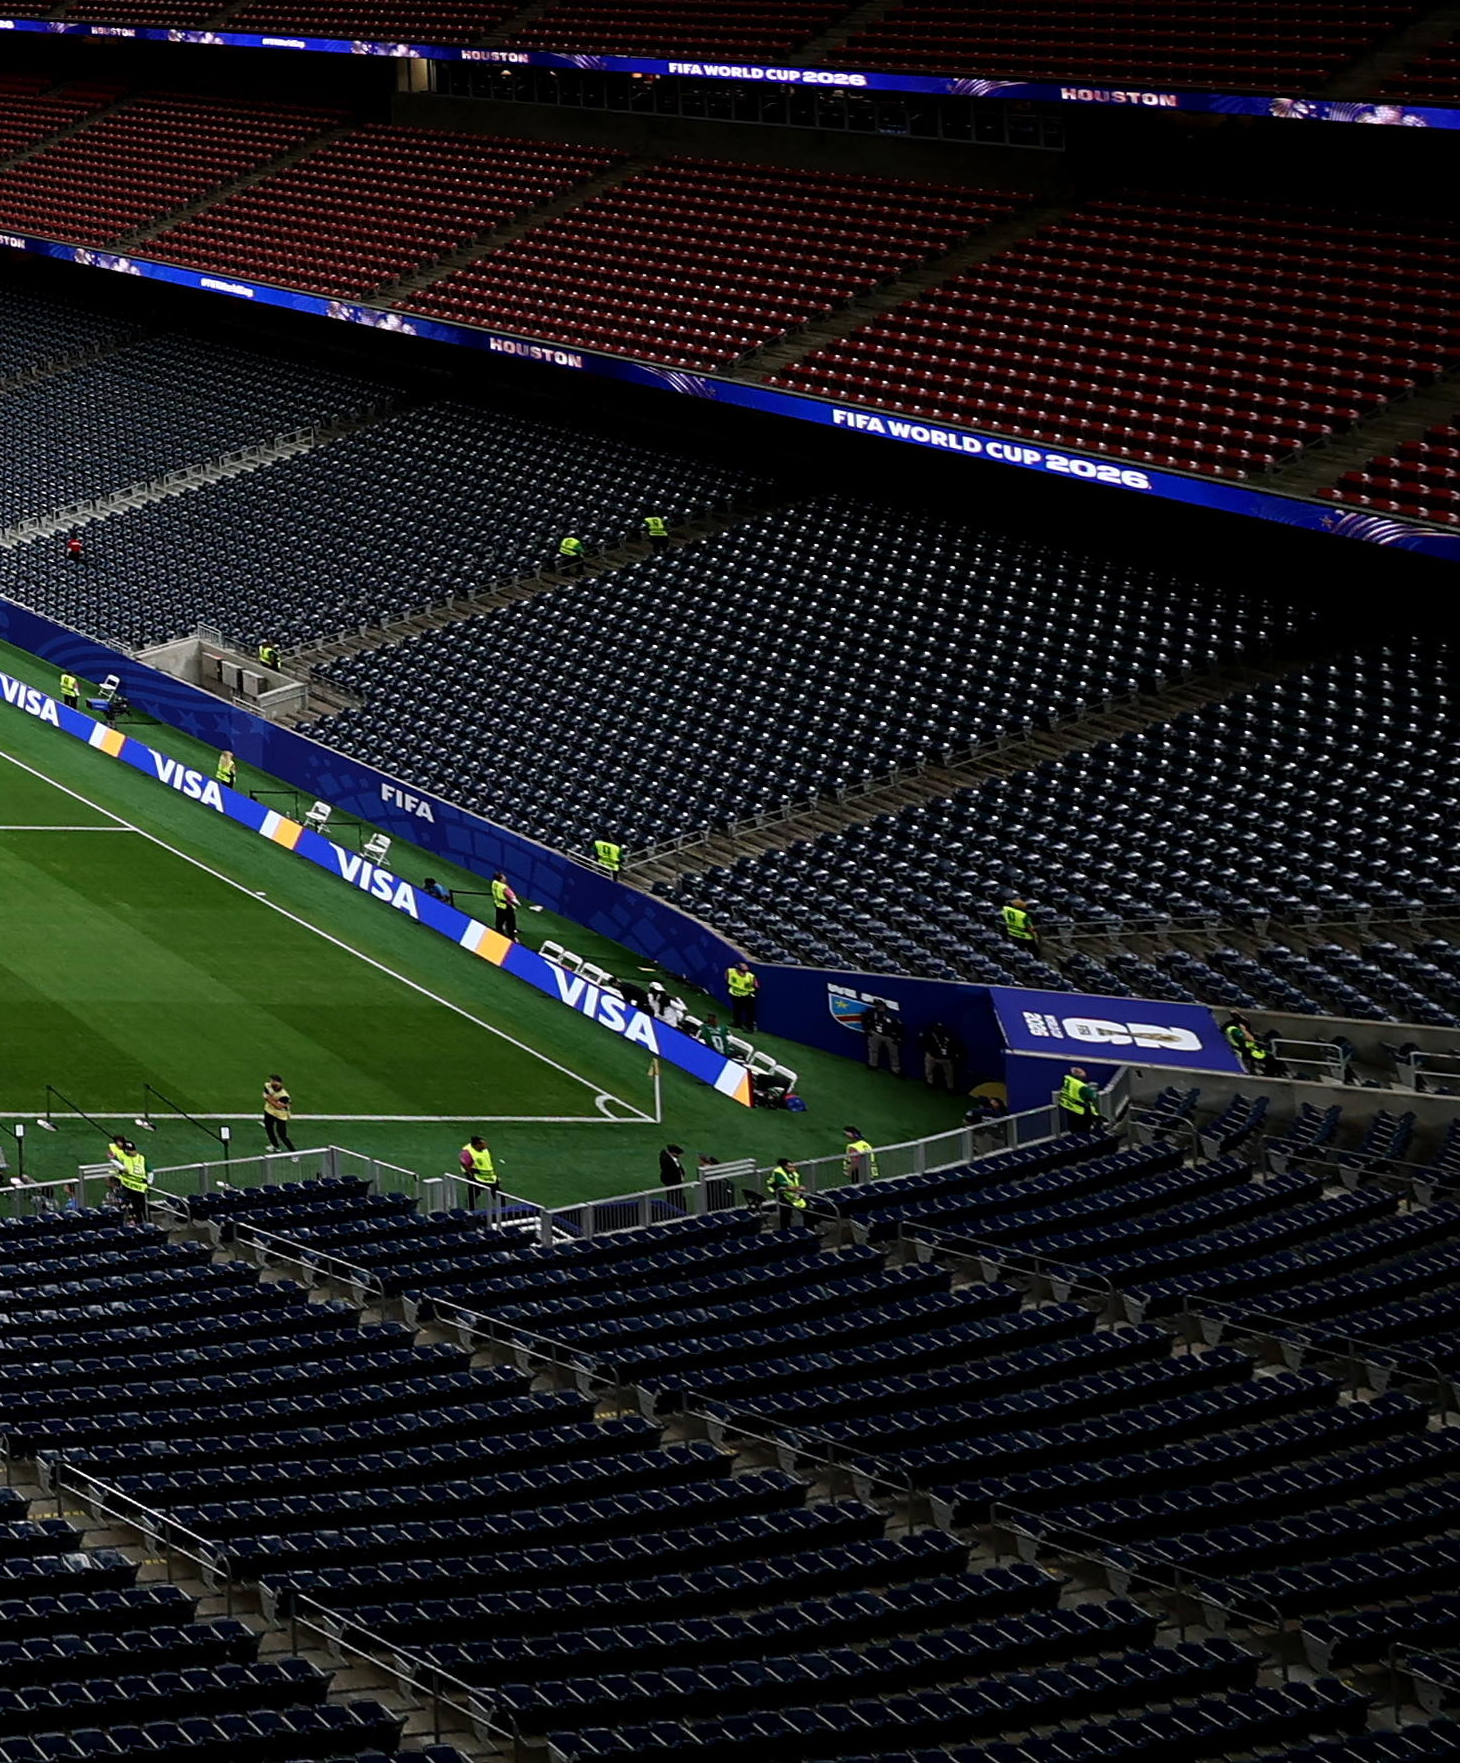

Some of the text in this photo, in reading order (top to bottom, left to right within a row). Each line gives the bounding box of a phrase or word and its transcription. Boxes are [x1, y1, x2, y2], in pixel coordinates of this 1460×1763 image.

[91, 26, 136, 38] HOUSTON
[461, 50, 529, 64] HOUSTON
[669, 62, 867, 86] FIFA WORLD CUP 2026
[1060, 87, 1178, 107] HOUSTON
[489, 338, 583, 369] HOUSTON
[832, 409, 1151, 489] FIFA WORLD CUP 2026
[148, 748, 224, 814] VISA
[381, 782, 435, 824] FIFA
[329, 841, 419, 919] VISA
[544, 960, 660, 1056] VISA
